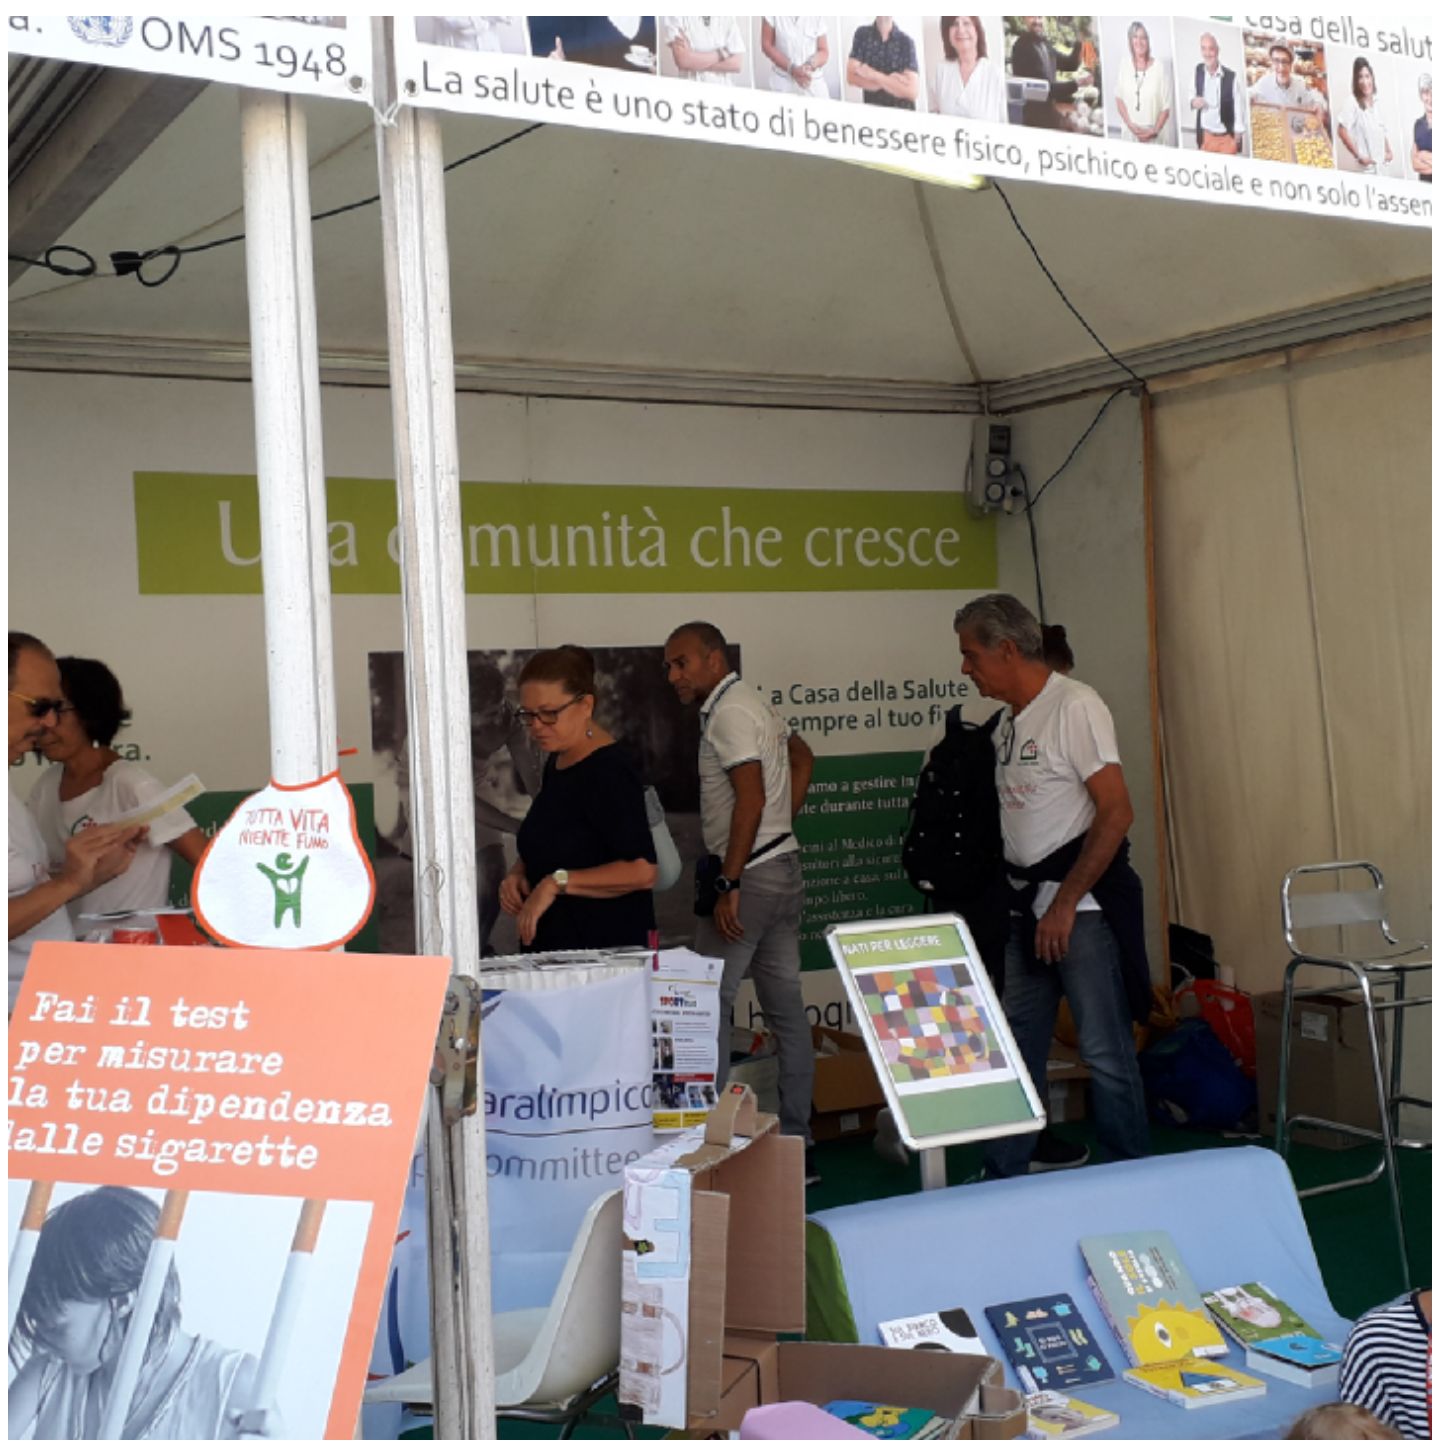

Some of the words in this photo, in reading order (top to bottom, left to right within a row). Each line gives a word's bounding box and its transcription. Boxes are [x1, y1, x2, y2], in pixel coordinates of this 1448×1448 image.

[141, 17, 241, 61] OMS
[254, 43, 347, 81] 1948
[1310, 16, 1370, 48] della
[423, 60, 462, 94] La
[474, 67, 575, 109] salute
[585, 79, 603, 114] è
[613, 99, 672, 122] uno
[682, 101, 758, 134] stato
[768, 106, 795, 138] di
[804, 108, 946, 157] benessere
[953, 128, 1031, 174] fisico,
[1038, 145, 1138, 182] psichico
[1145, 163, 1158, 182] e
[1165, 165, 1244, 195] sociale
[1251, 176, 1264, 196] e
[1270, 180, 1312, 202] non
[1317, 180, 1360, 208] solo
[387, 506, 667, 569] munità
[690, 506, 783, 568] che
[804, 526, 960, 568] cresce
[789, 684, 840, 704] Casa
[846, 680, 897, 702] della
[904, 678, 968, 700] Salute
[783, 714, 858, 737] empre
[864, 707, 881, 729] al
[888, 709, 923, 727] tuo
[289, 807, 329, 833] VITA
[29, 991, 95, 1024] Fai
[109, 996, 151, 1026] il
[170, 997, 250, 1030] test
[14, 1040, 87, 1071] per
[96, 1040, 284, 1076] misurare
[8, 1076, 49, 1108] la
[66, 1079, 132, 1113] tua
[147, 1084, 393, 1126] dipendenza
[484, 1079, 652, 1121] aralimpico
[114, 1129, 319, 1176] sigarette
[486, 1147, 641, 1181] ommittee
